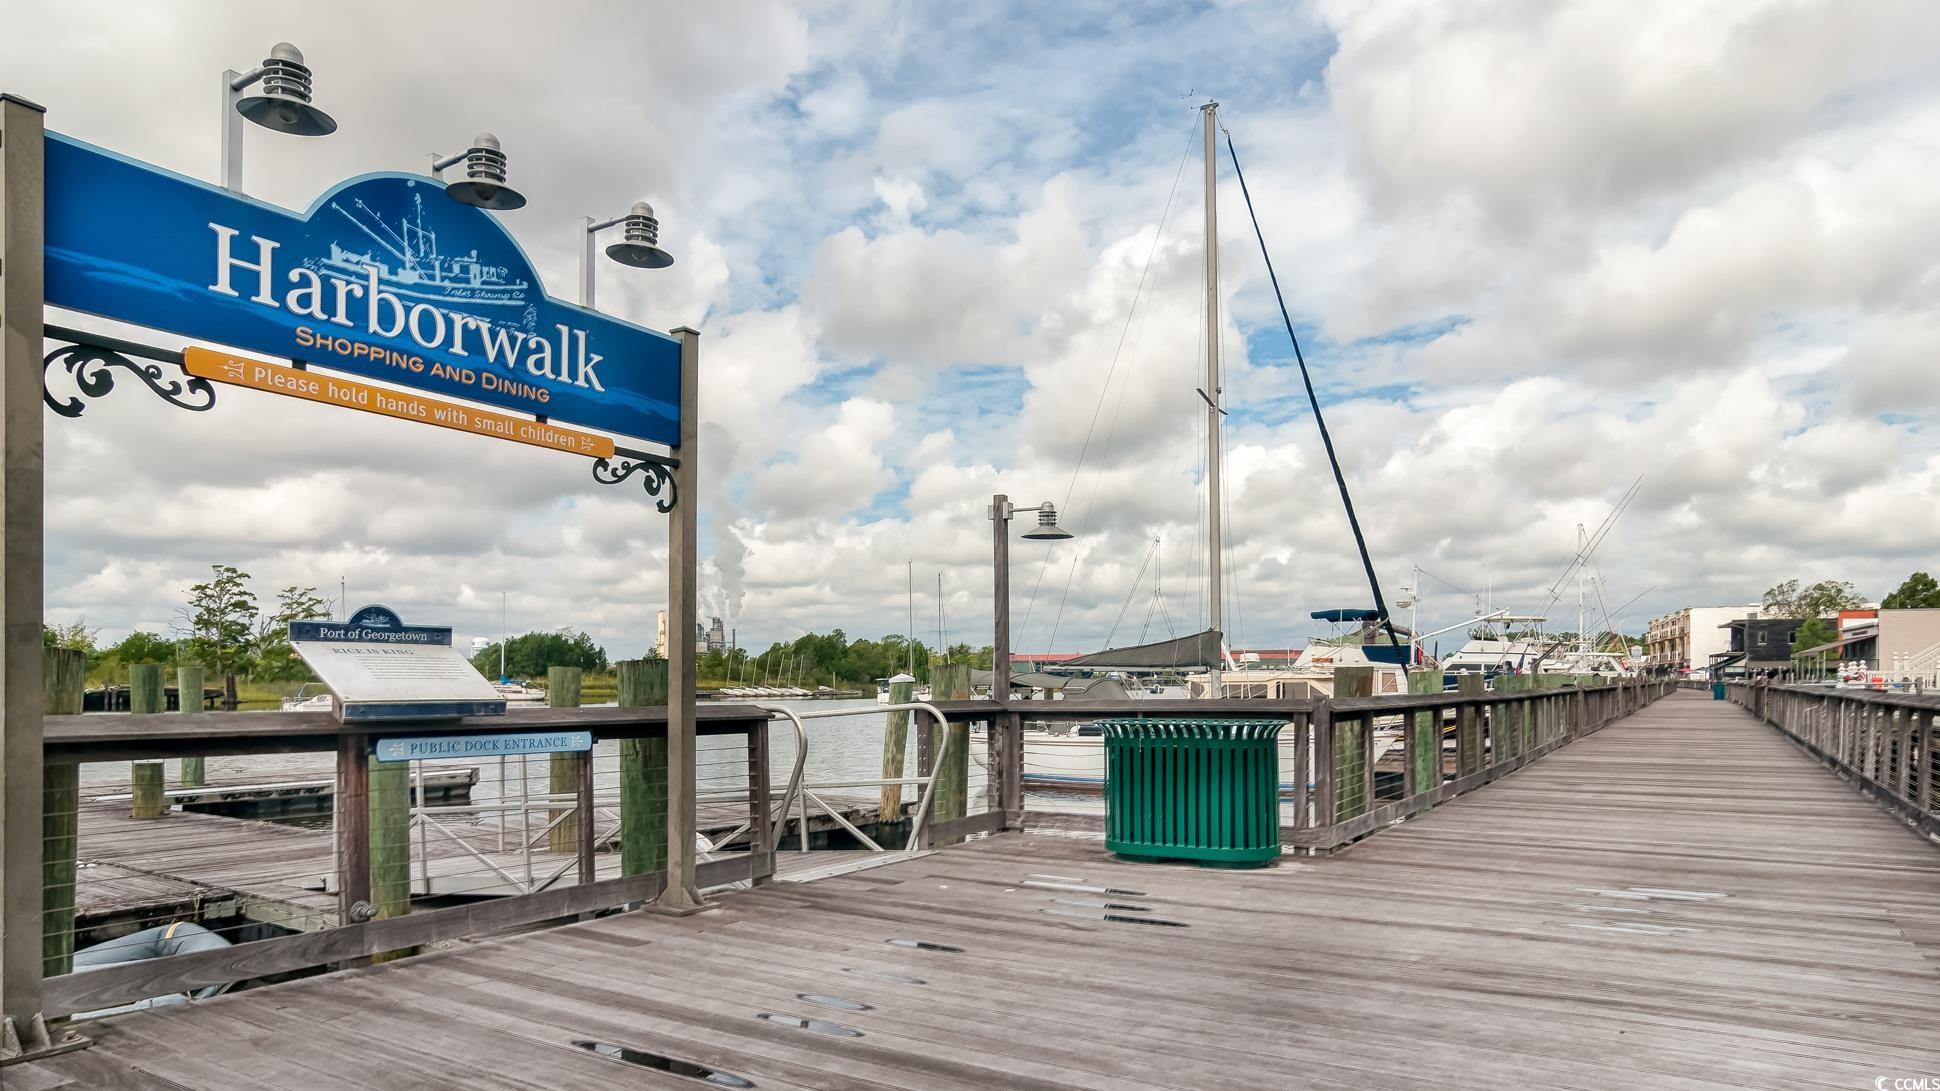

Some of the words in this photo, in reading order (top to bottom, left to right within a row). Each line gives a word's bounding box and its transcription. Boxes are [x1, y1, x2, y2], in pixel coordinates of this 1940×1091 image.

[207, 221, 606, 393] Harborwalk
[295, 326, 425, 373] SHOPPING
[430, 361, 476, 386] AND
[481, 372, 550, 403] DINING
[254, 366, 319, 395] Please
[328, 381, 368, 406] hold
[376, 392, 427, 417] hands
[434, 406, 468, 426] with
[474, 417, 514, 436] small
[520, 424, 575, 448] children
[319, 627, 344, 639] Port
[347, 629, 361, 639] of
[362, 629, 428, 642] Georgetown
[410, 741, 461, 754] PUBLIC
[464, 739, 501, 752] DOCK
[504, 736, 568, 750] ENTRANCE
